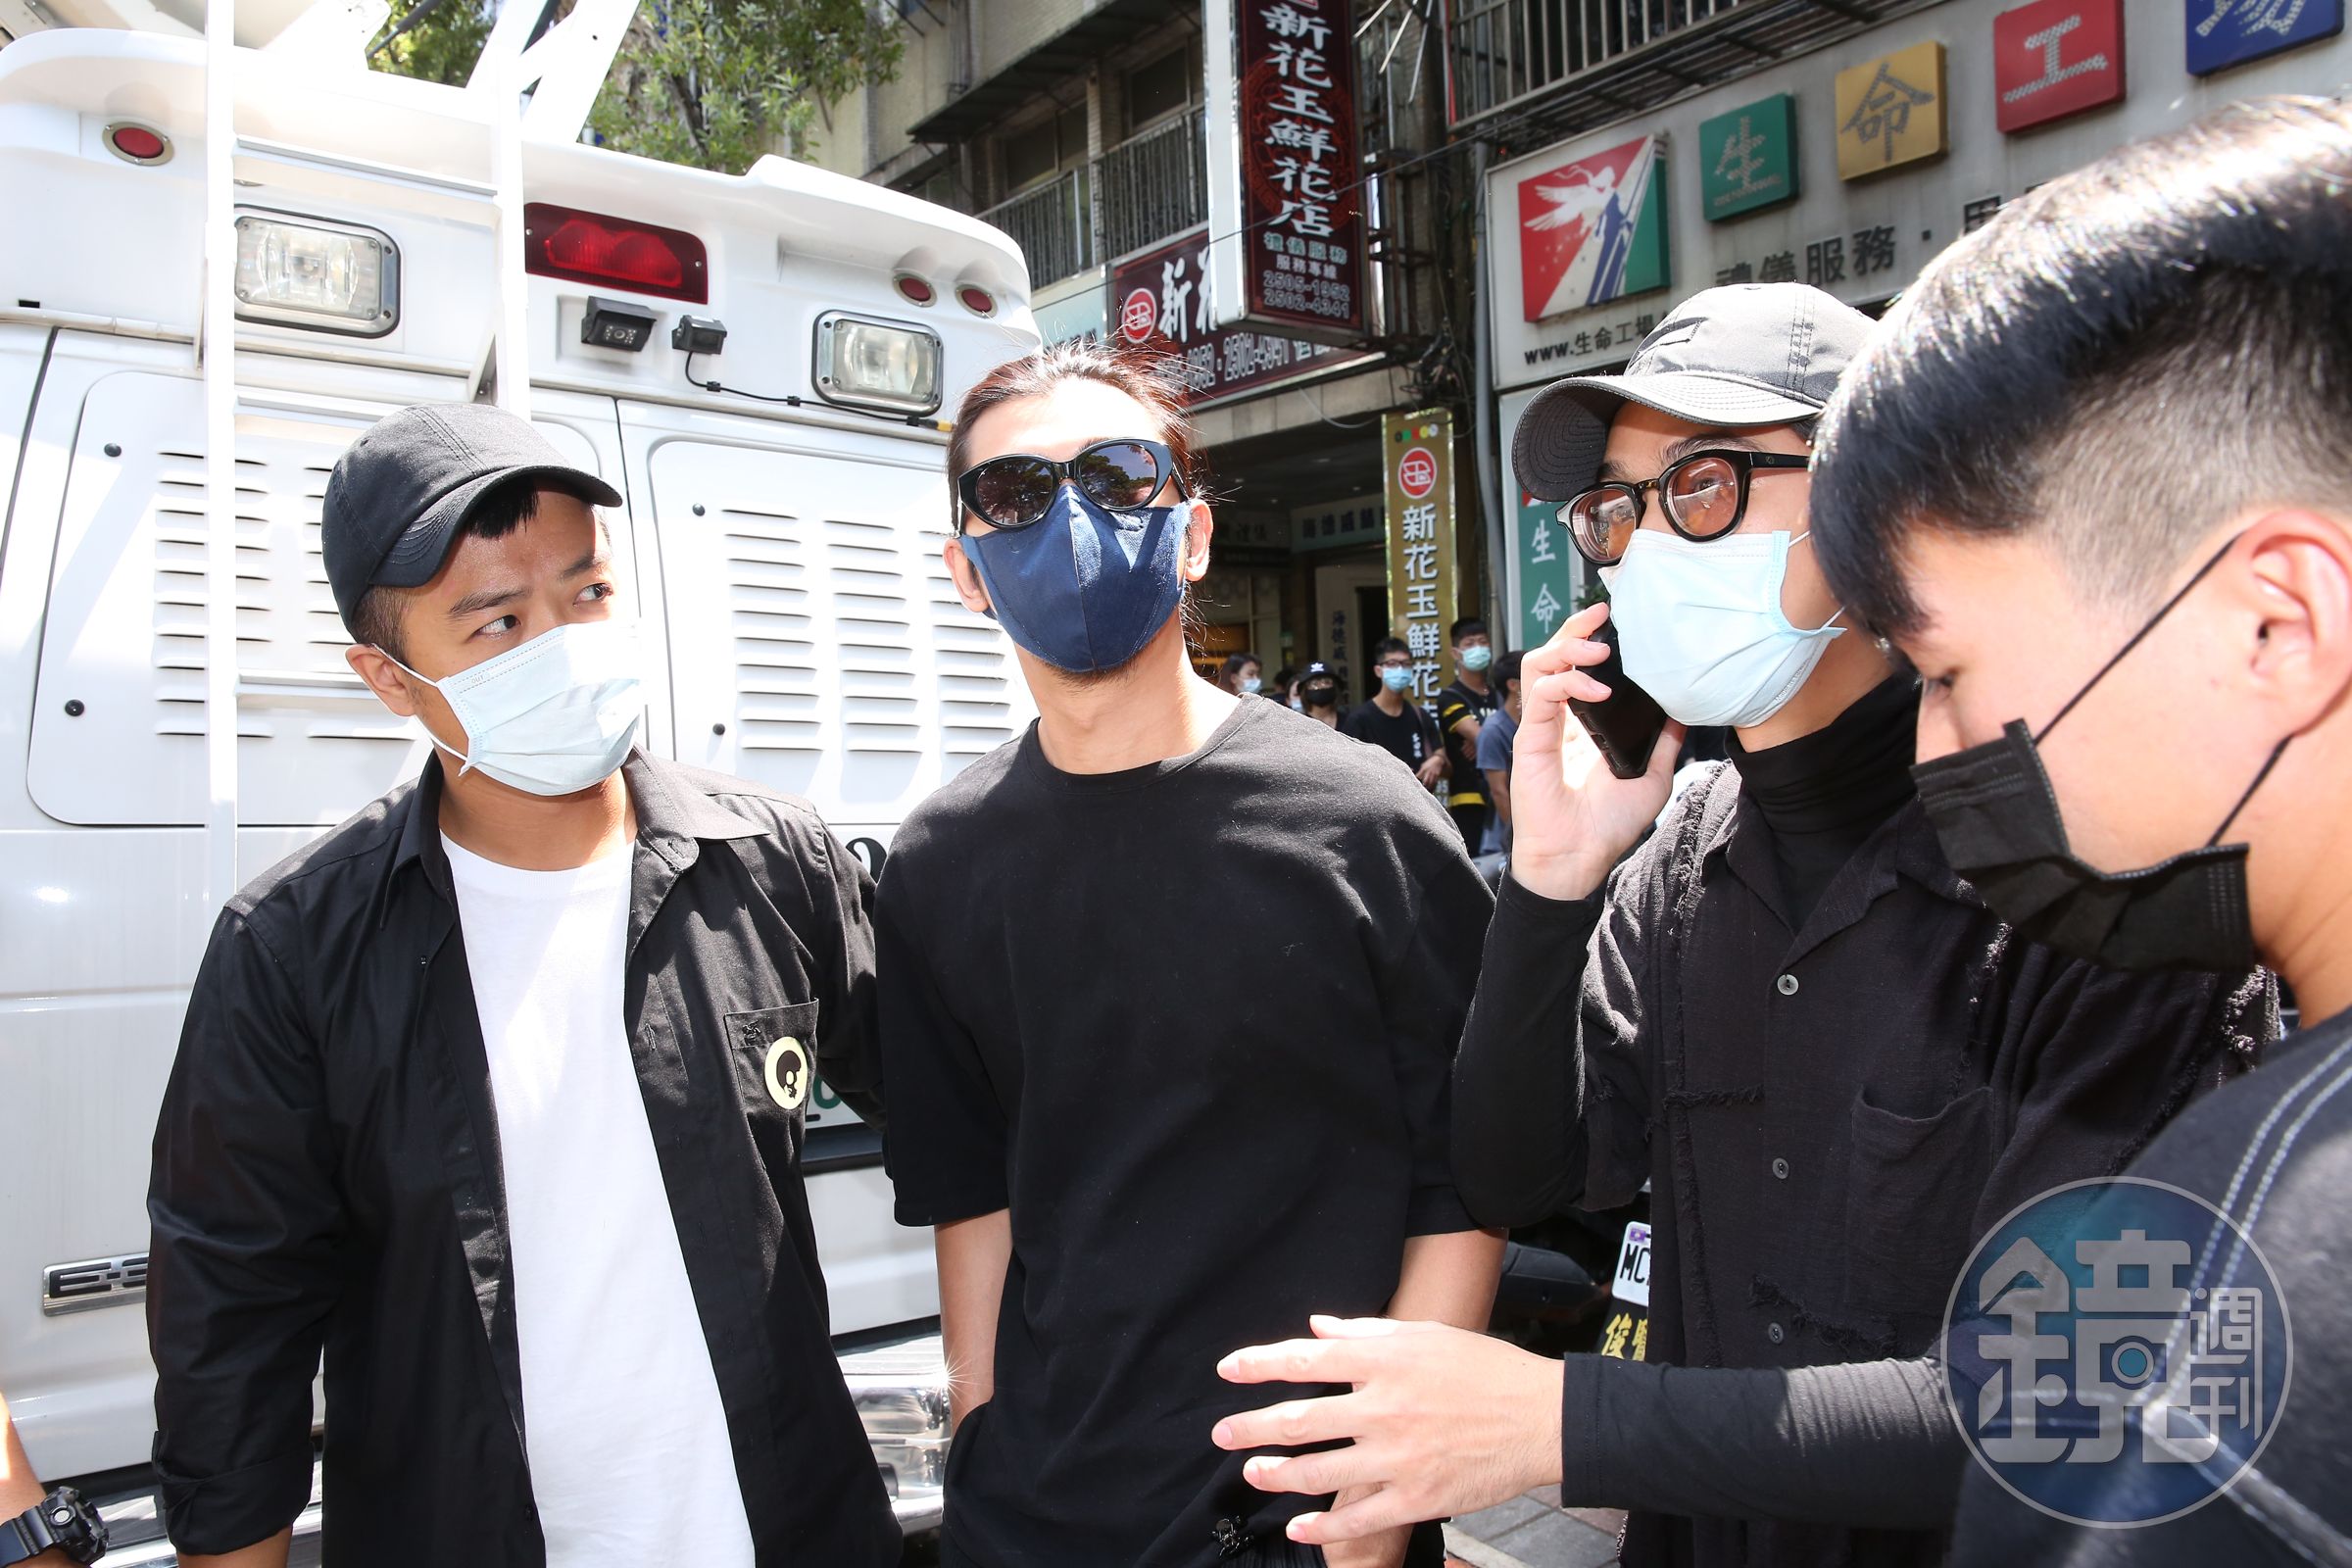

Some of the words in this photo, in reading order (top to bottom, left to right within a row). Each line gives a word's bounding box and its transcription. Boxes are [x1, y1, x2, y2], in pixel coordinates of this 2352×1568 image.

[1260, 3, 1339, 237] 新花玉鮮花店
[1525, 311, 1669, 365] www.生命工場
[1531, 518, 1562, 634] 生命
[1620, 1243, 1650, 1286] MC
